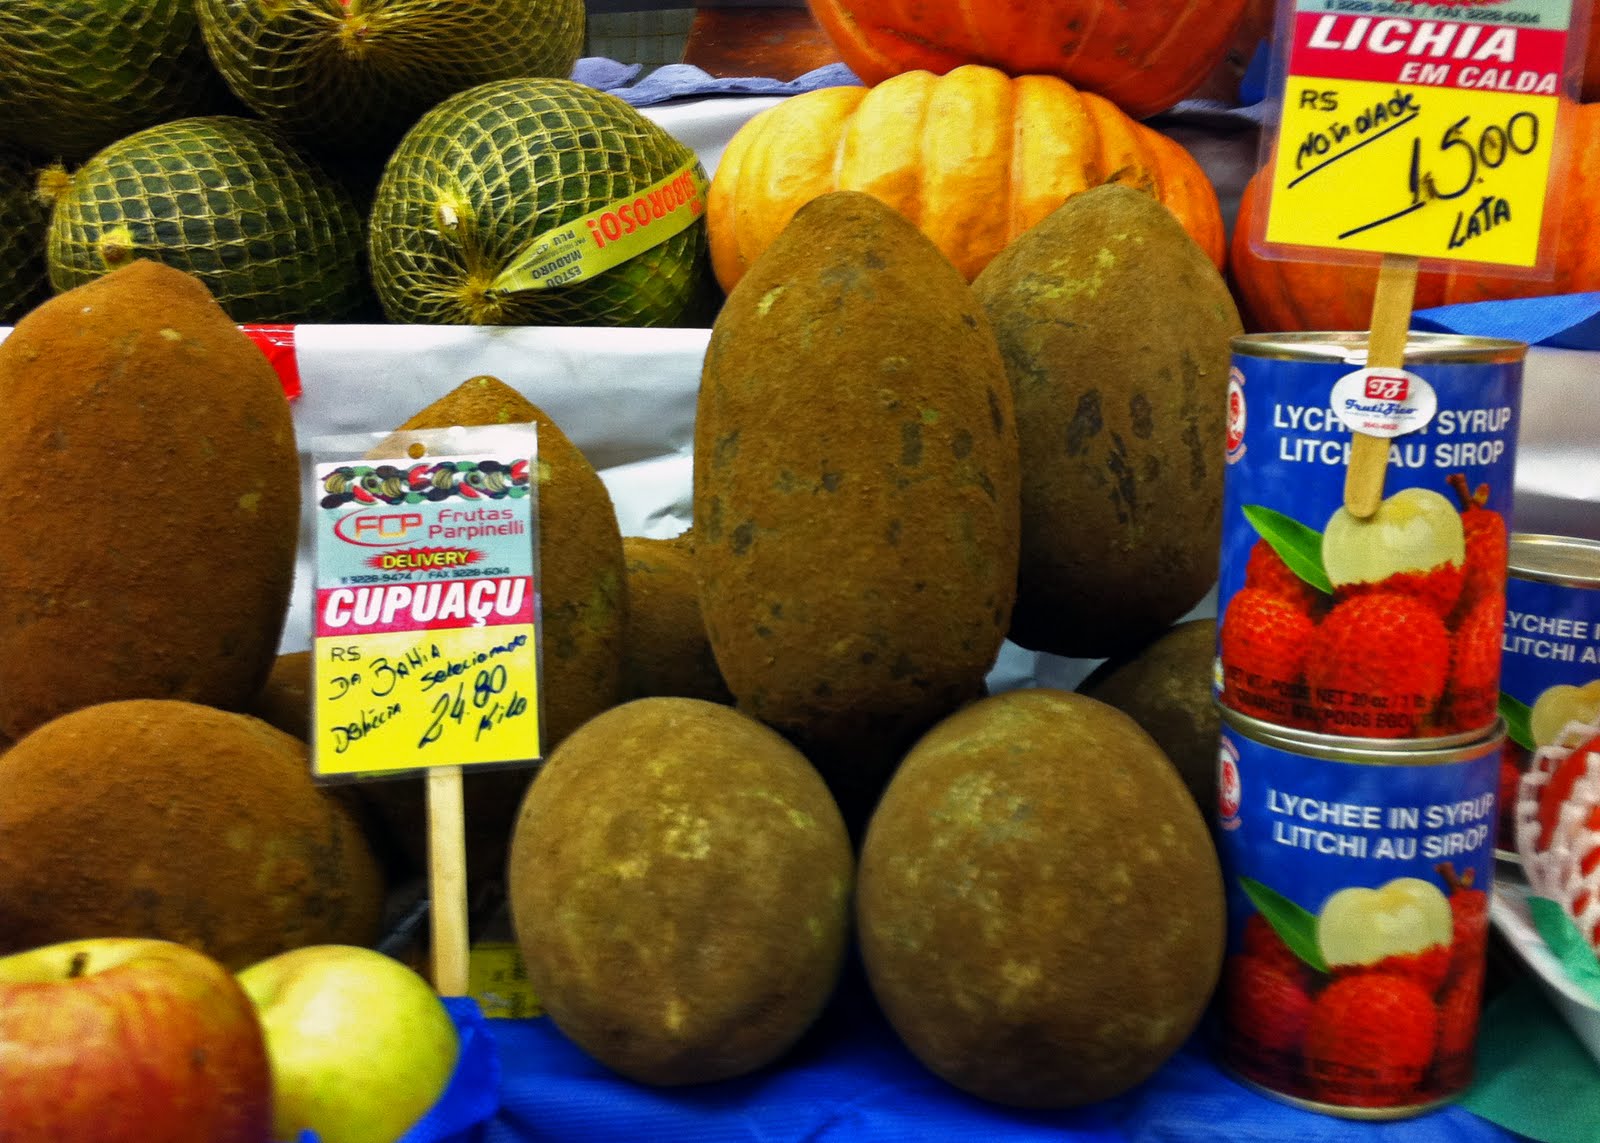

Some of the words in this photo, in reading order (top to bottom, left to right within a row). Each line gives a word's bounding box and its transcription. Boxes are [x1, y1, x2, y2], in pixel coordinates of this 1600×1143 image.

[1308, 15, 1518, 63] LICHIA
[1398, 62, 1450, 86] EM
[1456, 66, 1558, 94] CALDA
[553, 229, 576, 246] PLU
[1448, 196, 1511, 250] LATA
[531, 249, 584, 281] MADURO
[547, 265, 583, 288] ESTOU
[1274, 404, 1354, 433] LYCH
[1437, 406, 1511, 436] SYRUP
[1280, 437, 1351, 466] LITC
[1387, 443, 1426, 468] AU
[1434, 440, 1505, 467] SIROP
[429, 521, 524, 540] Parpinelli
[438, 507, 513, 523] Frutas
[383, 551, 469, 569] DELIVERY
[324, 578, 526, 627] CUPUAÇU
[1501, 633, 1575, 662] LITCHI
[1267, 788, 1381, 829] LYCHEE
[1388, 807, 1419, 830] IN
[1424, 793, 1495, 828] SYRUP
[1273, 822, 1367, 858] LITCHI
[1375, 835, 1416, 860] AU
[1423, 825, 1488, 858] SIROP
